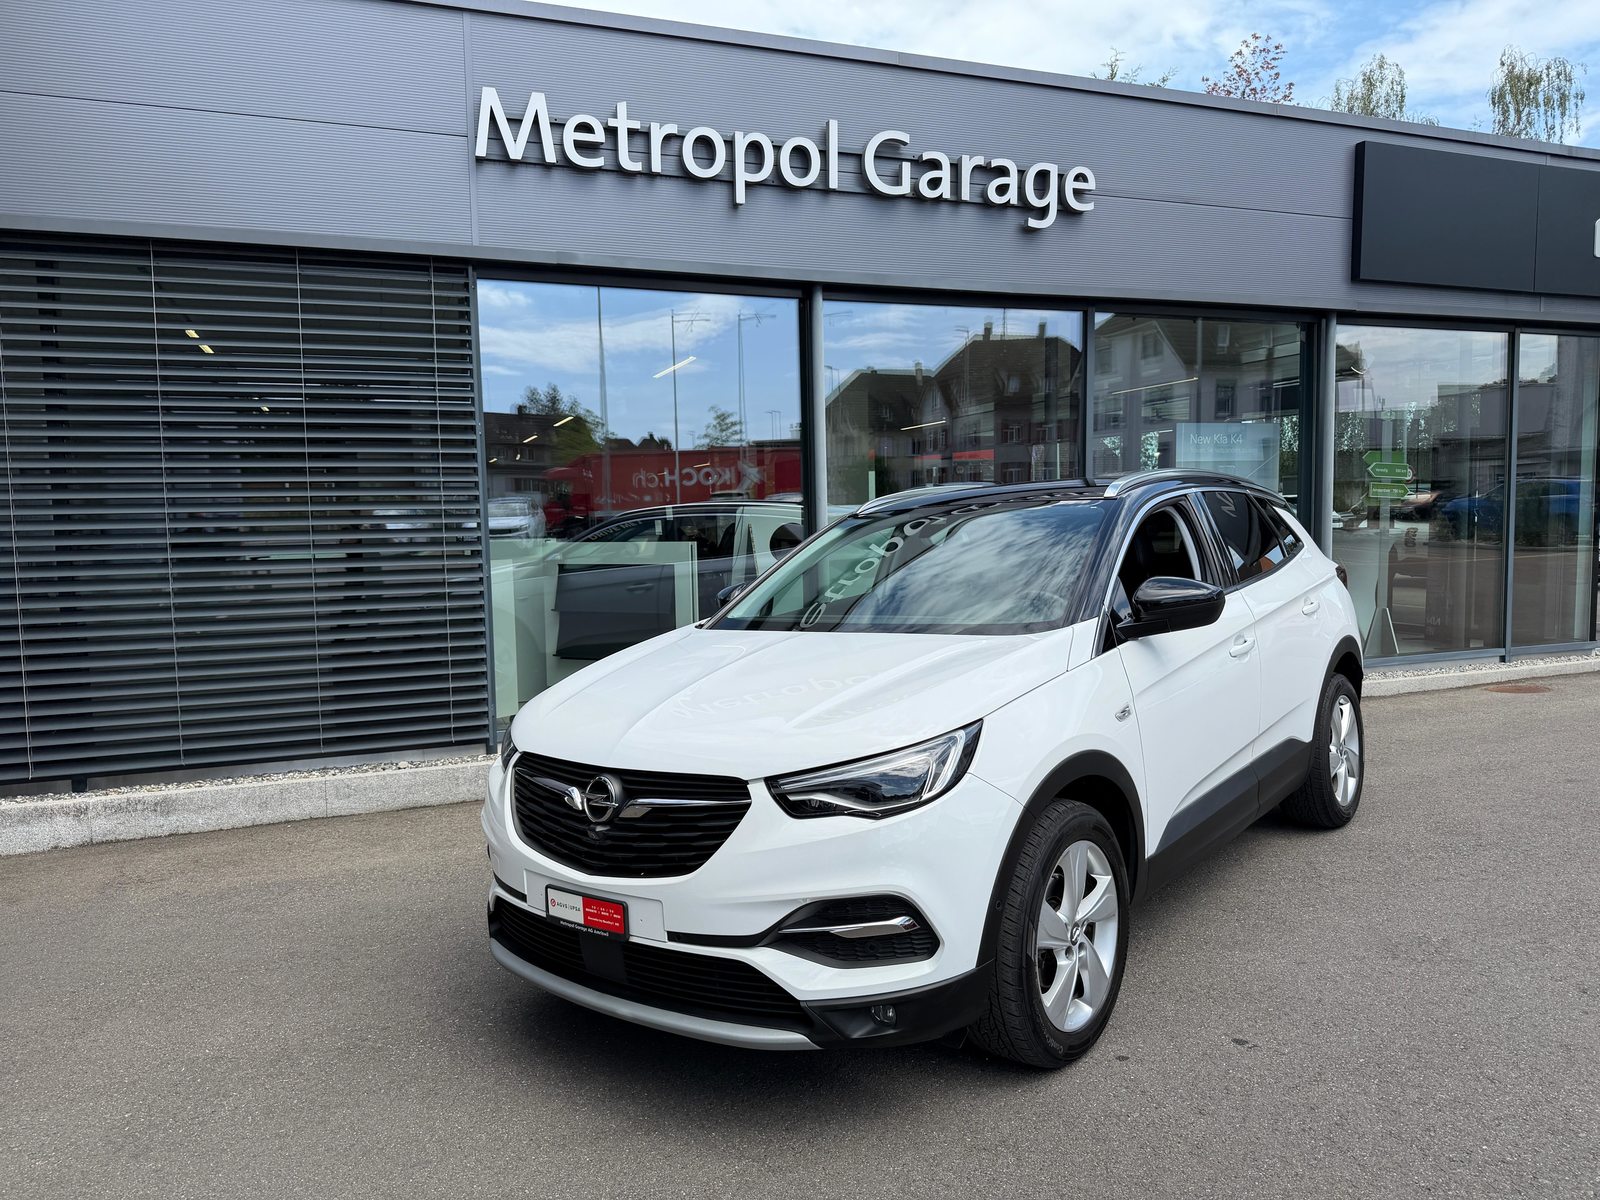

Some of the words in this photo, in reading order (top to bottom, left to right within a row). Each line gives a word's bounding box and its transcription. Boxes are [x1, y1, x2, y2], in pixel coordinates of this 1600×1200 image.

[475, 86, 839, 207] Metropol
[862, 129, 1096, 229] Garage
[1190, 433, 1211, 444] New
[1213, 433, 1228, 444] Kia
[1230, 433, 1242, 444] K4
[590, 526, 620, 541] DRIVE
